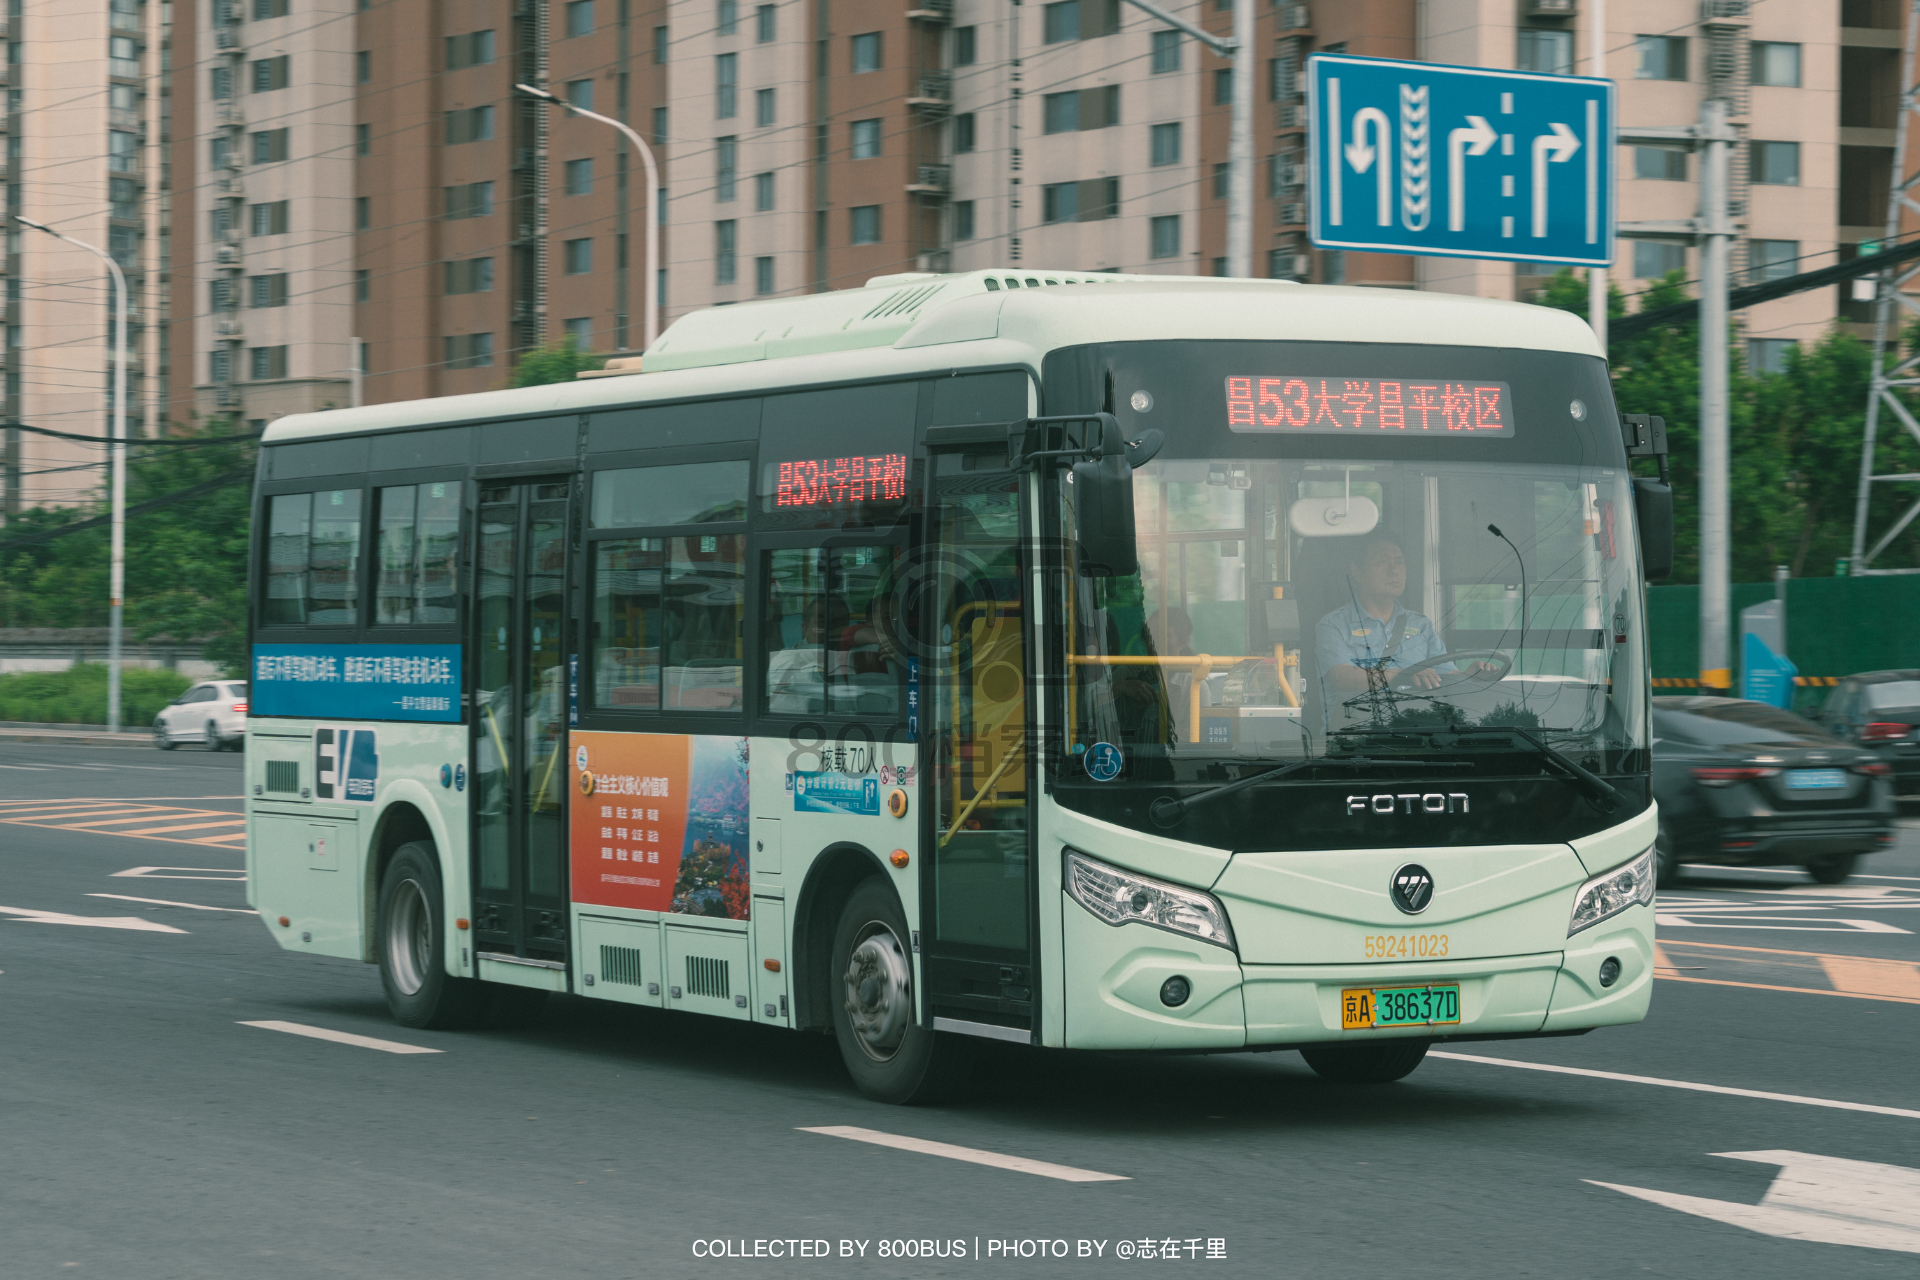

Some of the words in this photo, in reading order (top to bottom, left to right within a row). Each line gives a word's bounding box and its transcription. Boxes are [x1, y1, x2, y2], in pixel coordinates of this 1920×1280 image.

[1229, 377, 1503, 430] 昌53大学昌平校区
[777, 454, 906, 506] 昌53大学昌平校
[909, 665, 918, 733] 上车门
[820, 746, 878, 774] 核载70人
[1347, 793, 1469, 816] FOTON
[1365, 934, 1449, 958] 59241023
